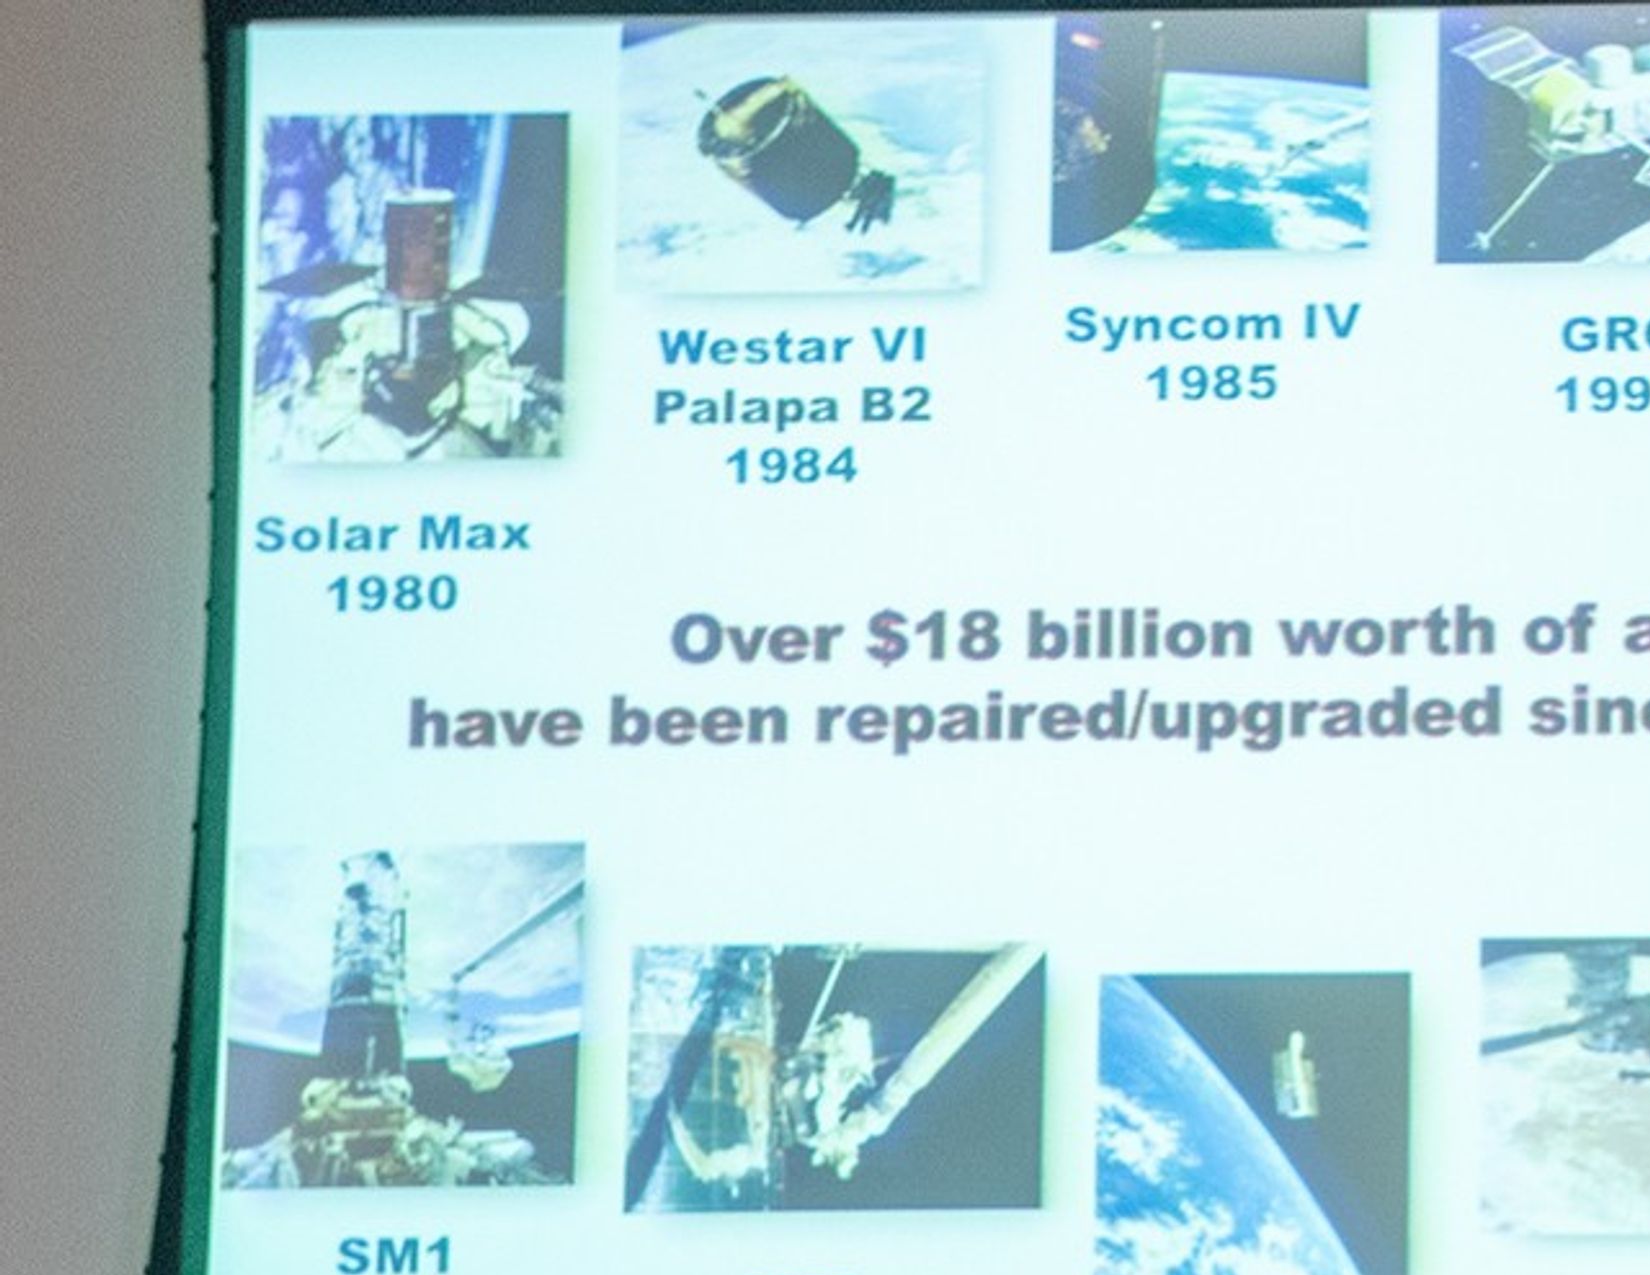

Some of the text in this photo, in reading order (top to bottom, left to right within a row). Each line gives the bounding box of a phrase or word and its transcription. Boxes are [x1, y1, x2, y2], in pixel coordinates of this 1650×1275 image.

[659, 326, 926, 365] Westar VI
[1066, 302, 1361, 354] Syncom IV
[1147, 363, 1278, 401] 1985
[654, 385, 931, 433] Palapa B2
[727, 446, 858, 484] 1984
[254, 514, 529, 553] Solar Max
[329, 574, 458, 612] 1980
[670, 612, 845, 665] Over
[867, 608, 1001, 666] $18
[1028, 607, 1252, 660] billion
[1279, 604, 1495, 656] worth
[1524, 602, 1597, 654] of
[408, 696, 584, 749] have
[609, 694, 789, 746] been
[817, 684, 1502, 756] repaired/upgraded
[337, 1236, 450, 1275] SM1
